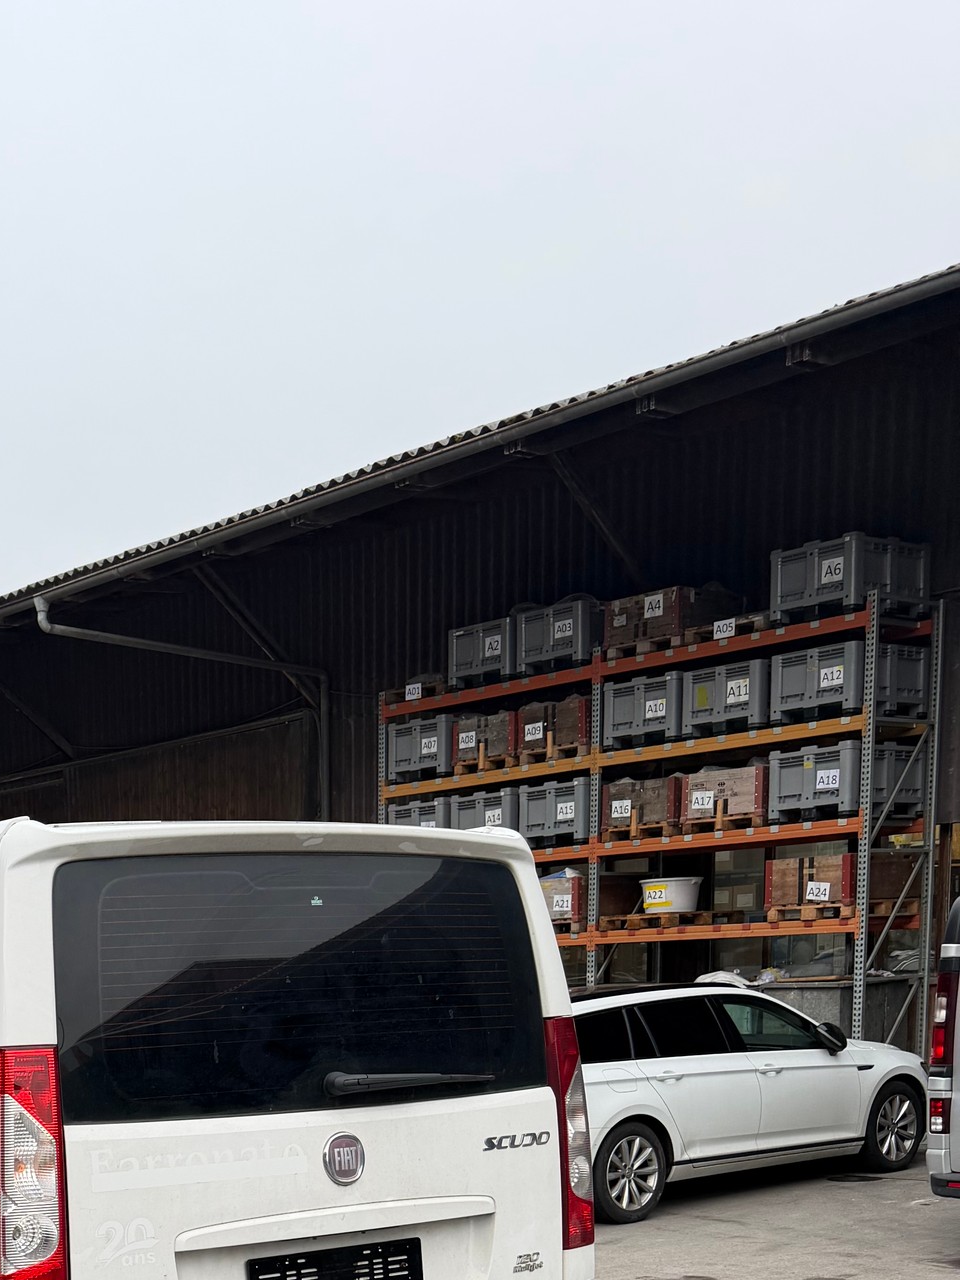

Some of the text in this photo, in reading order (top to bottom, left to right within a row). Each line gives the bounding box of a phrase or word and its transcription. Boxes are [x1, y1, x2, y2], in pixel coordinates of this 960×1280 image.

[823, 562, 842, 578] A6
[646, 599, 661, 614] A4
[556, 622, 572, 635] A03
[715, 622, 734, 635] A05
[487, 640, 500, 652] A2
[822, 669, 842, 683] A12
[406, 686, 421, 697] A01
[727, 684, 750, 698] A11
[646, 702, 664, 714] A10
[526, 725, 541, 737] A09
[422, 740, 437, 750] A07
[460, 734, 475, 744] A08
[817, 774, 838, 786] A18
[693, 796, 712, 806] A17
[558, 804, 574, 816] A15
[612, 804, 630, 815] A16
[486, 813, 501, 825] A14
[646, 889, 664, 900] A22
[807, 887, 827, 898] A24
[554, 899, 570, 909] A21
[482, 1130, 551, 1152] SCUDO
[333, 1145, 358, 1171] FIAT
[95, 1217, 156, 1263] 20
[121, 1251, 156, 1267] ans
